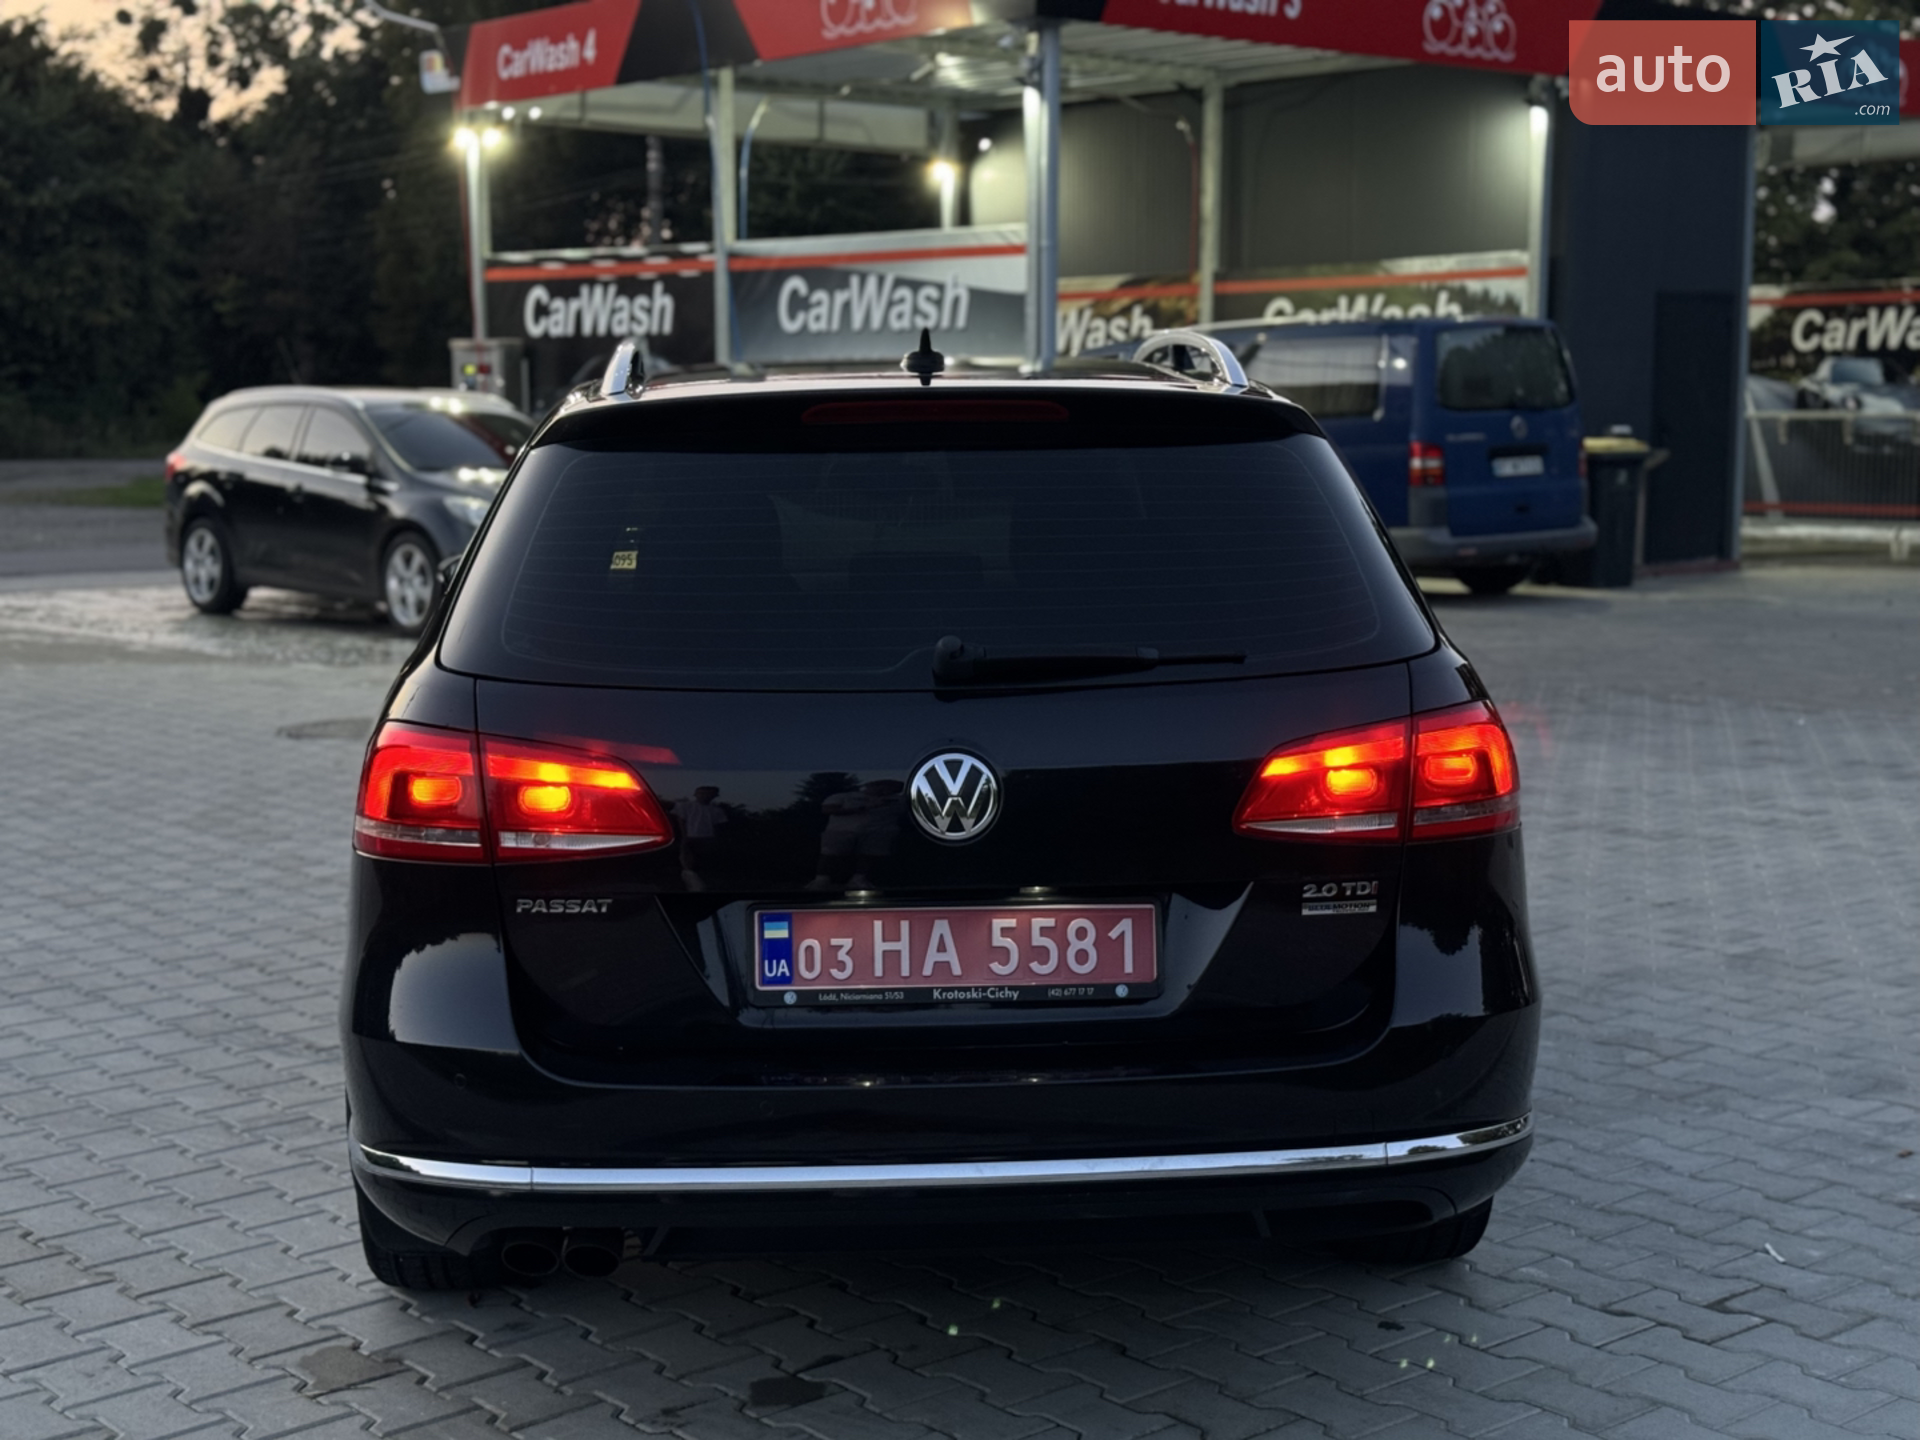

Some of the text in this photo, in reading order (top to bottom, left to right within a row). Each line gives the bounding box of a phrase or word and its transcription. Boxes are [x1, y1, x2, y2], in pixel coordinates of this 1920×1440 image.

[496, 28, 598, 80] CarWash 4
[523, 281, 675, 339] CarWash
[777, 274, 970, 335] CarWash
[515, 898, 613, 913] PASSAT
[1301, 880, 1379, 898] 2.0 TDI
[798, 917, 1133, 980] 03 HA 5581
[764, 959, 790, 978] UA
[933, 987, 1020, 1001] Krotoski-Cichy
